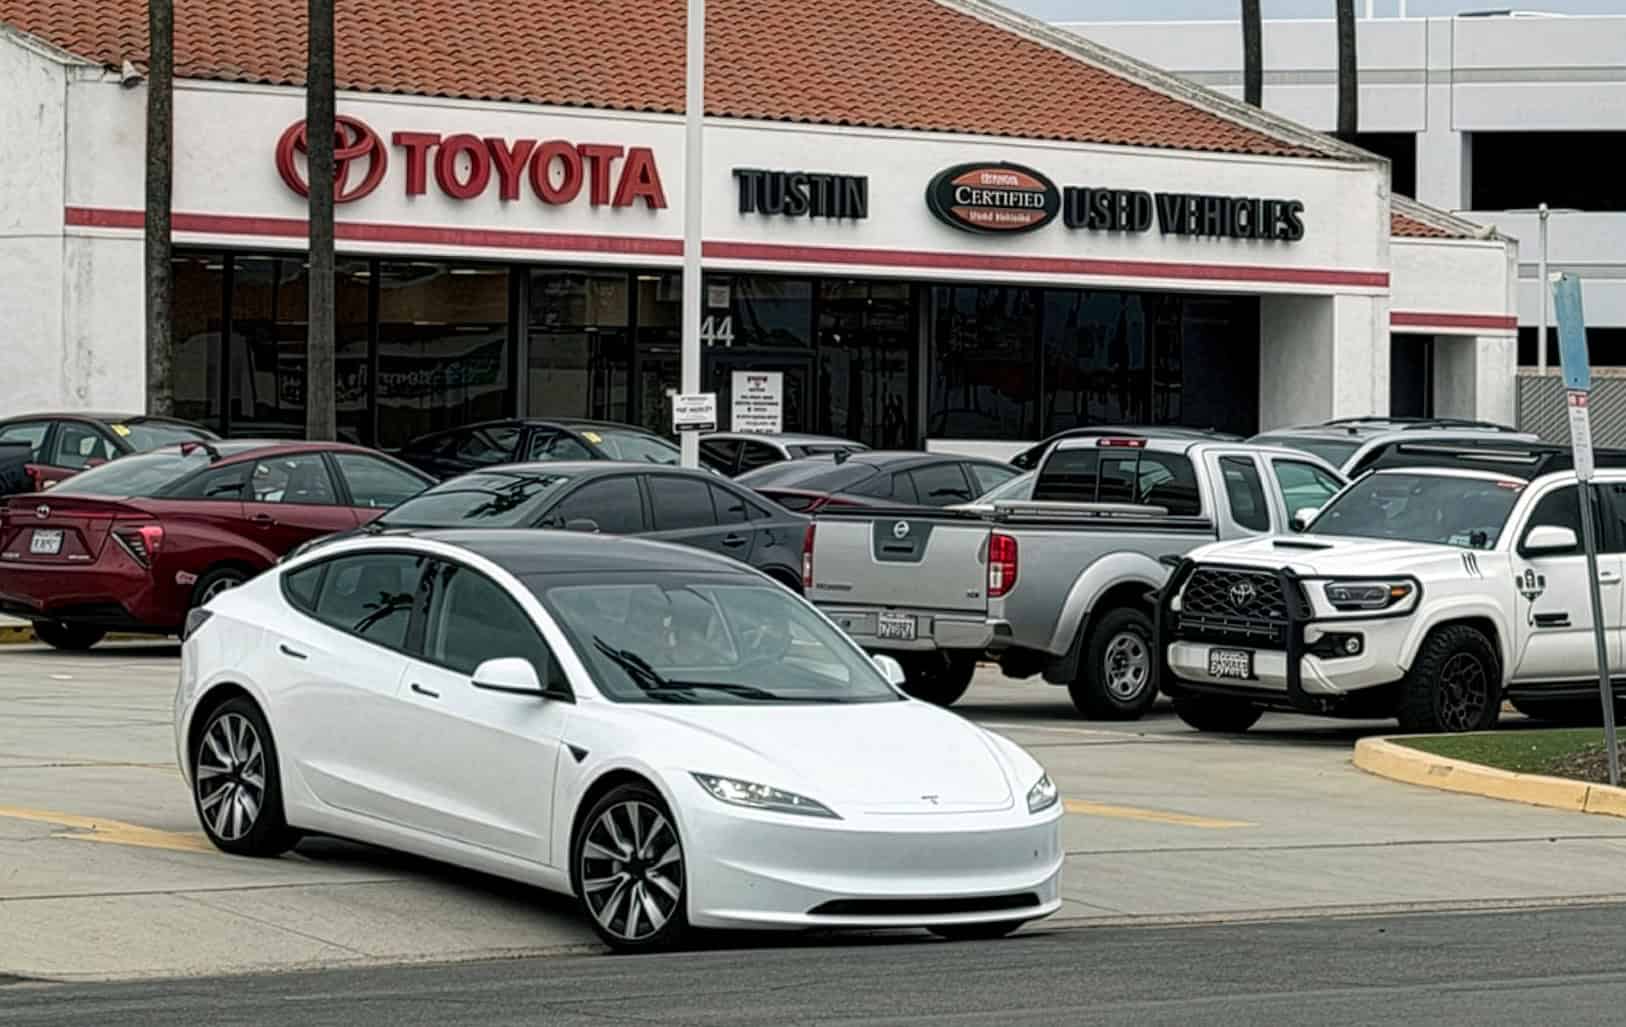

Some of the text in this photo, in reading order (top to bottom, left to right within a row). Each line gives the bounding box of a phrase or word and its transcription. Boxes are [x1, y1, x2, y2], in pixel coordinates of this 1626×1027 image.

[392, 131, 667, 209] TOYOTA
[732, 168, 868, 219] TUSTIN
[955, 186, 1045, 209] CERTIFIED
[1063, 187, 1304, 241] USED VEHICLES
[699, 315, 734, 347] 44
